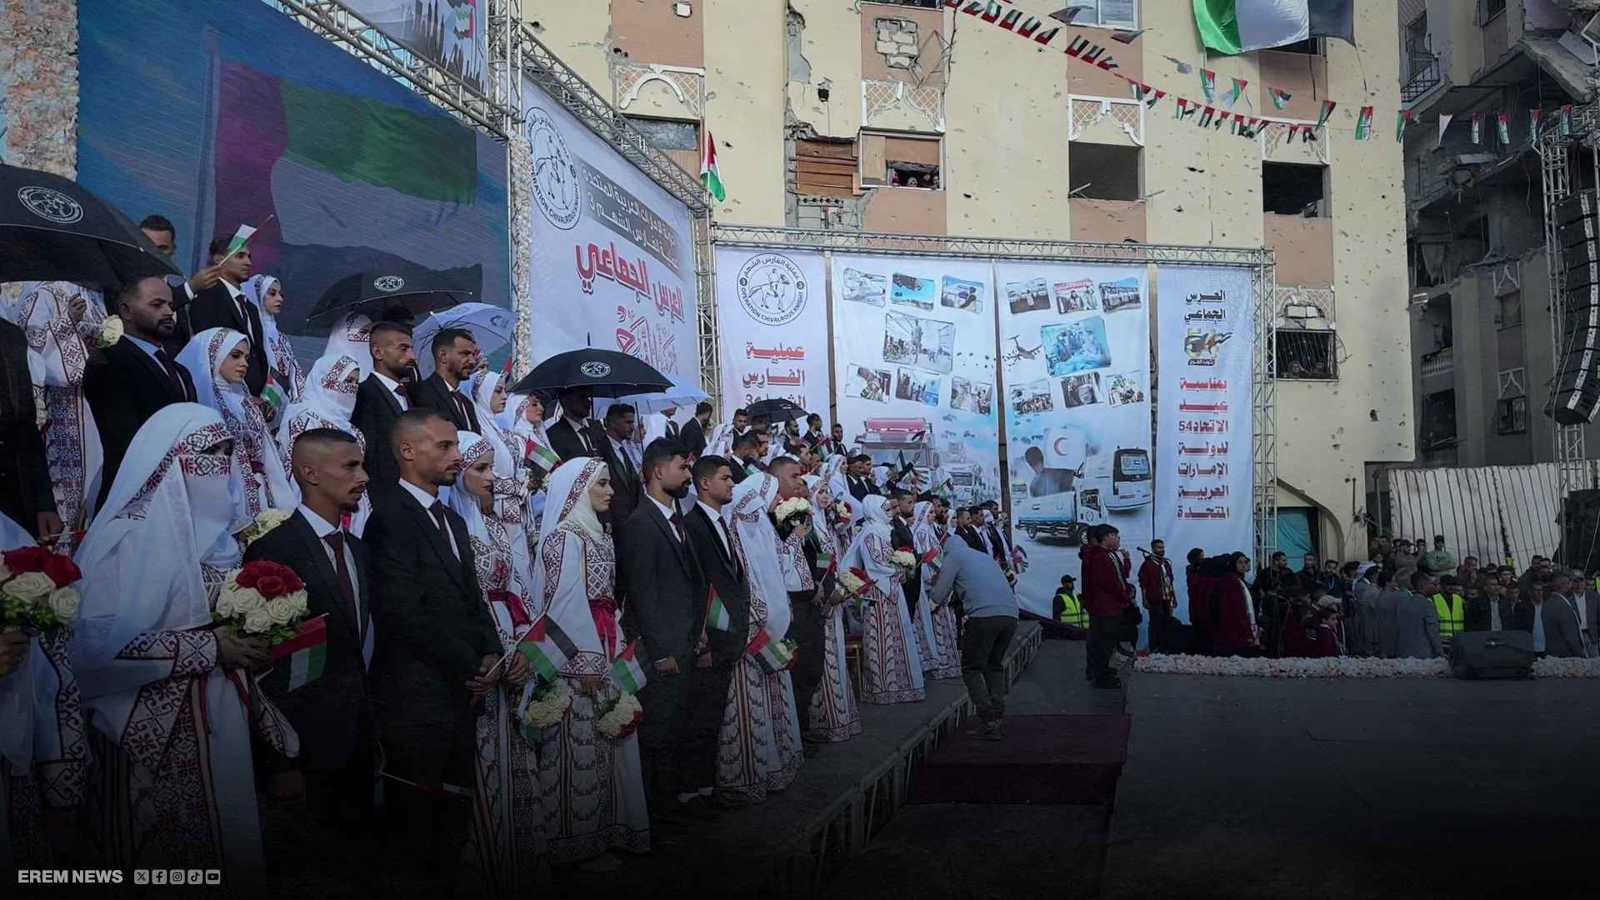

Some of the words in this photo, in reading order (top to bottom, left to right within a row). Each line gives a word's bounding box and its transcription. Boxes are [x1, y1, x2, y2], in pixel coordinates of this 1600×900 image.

[575, 241, 651, 303] الجماعي
[1185, 289, 1226, 305] العرس
[1184, 308, 1226, 325] الجماعي
[745, 341, 805, 364] عملية
[742, 368, 806, 389] الفارس
[1179, 377, 1227, 392] بمناسبة
[1179, 400, 1228, 415] عيد
[1178, 441, 1228, 457] لدولة
[1178, 485, 1229, 500] العربية
[1177, 505, 1229, 520] المتحدة
